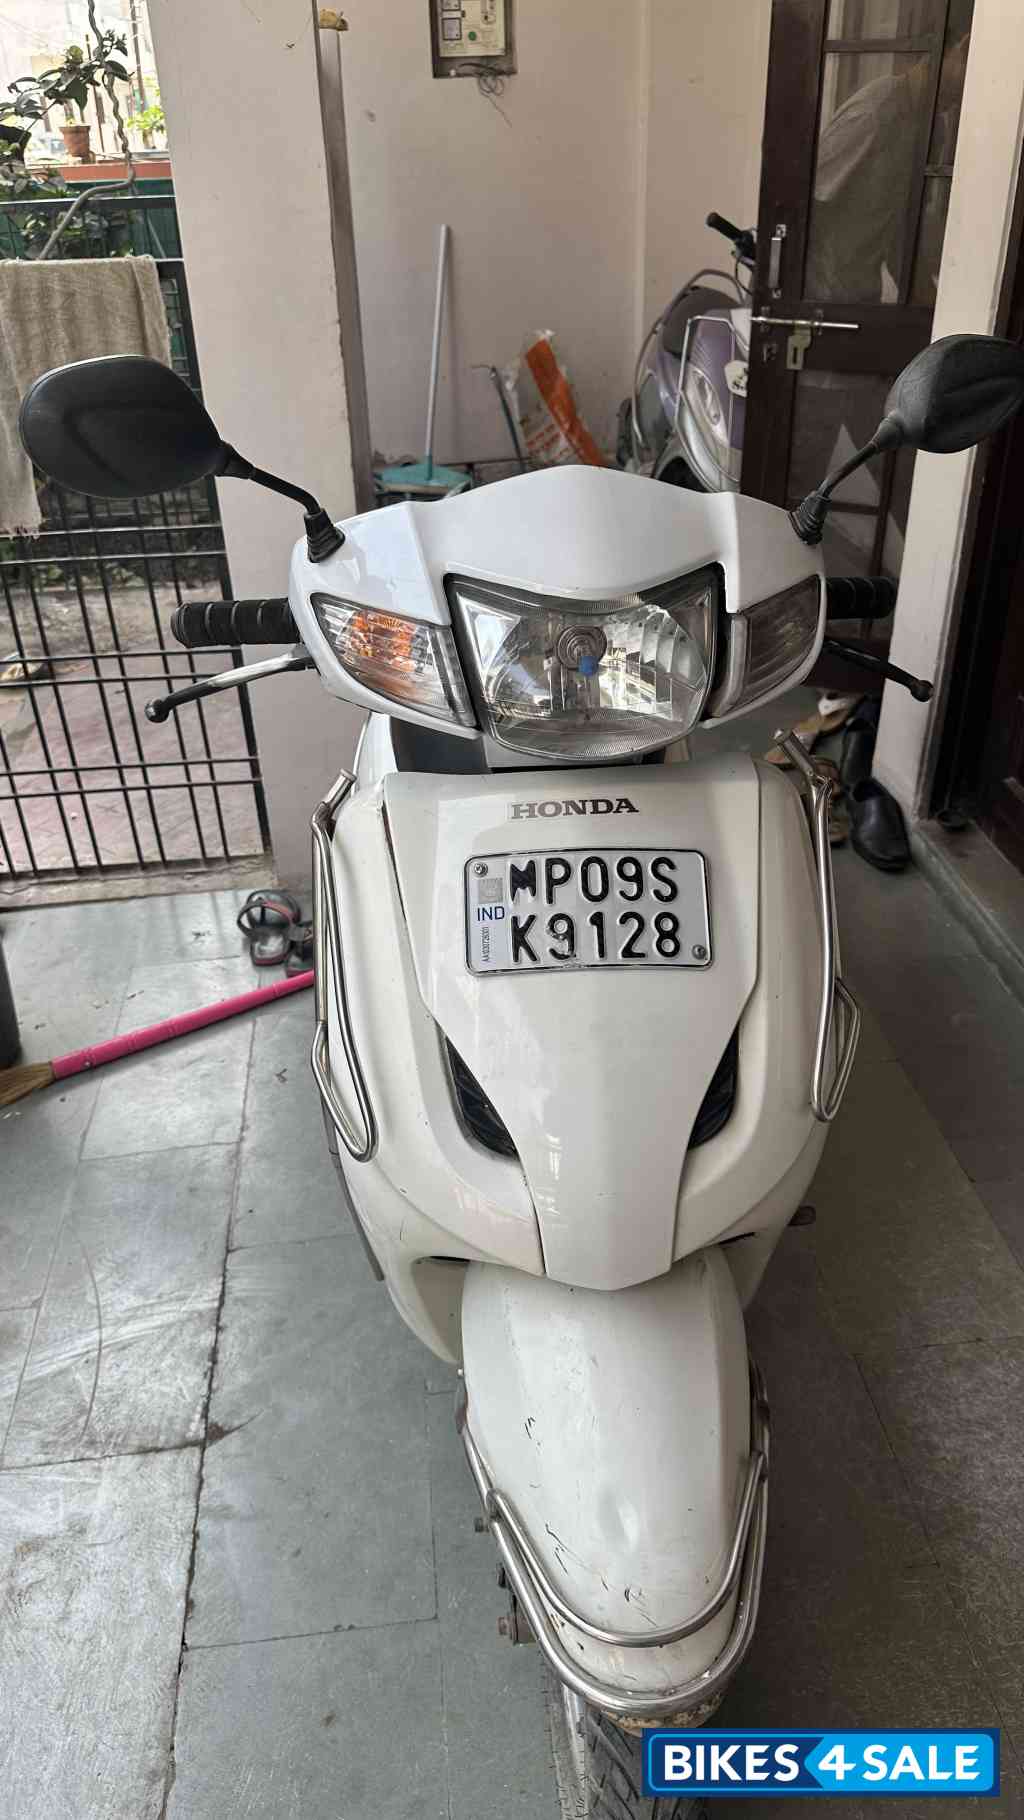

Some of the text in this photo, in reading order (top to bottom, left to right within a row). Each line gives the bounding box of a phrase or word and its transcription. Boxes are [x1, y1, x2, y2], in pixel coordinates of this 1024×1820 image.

[511, 798, 640, 819] HONDA
[509, 856, 679, 904] MP09S
[477, 906, 505, 921] IND
[511, 911, 681, 962] K9128
